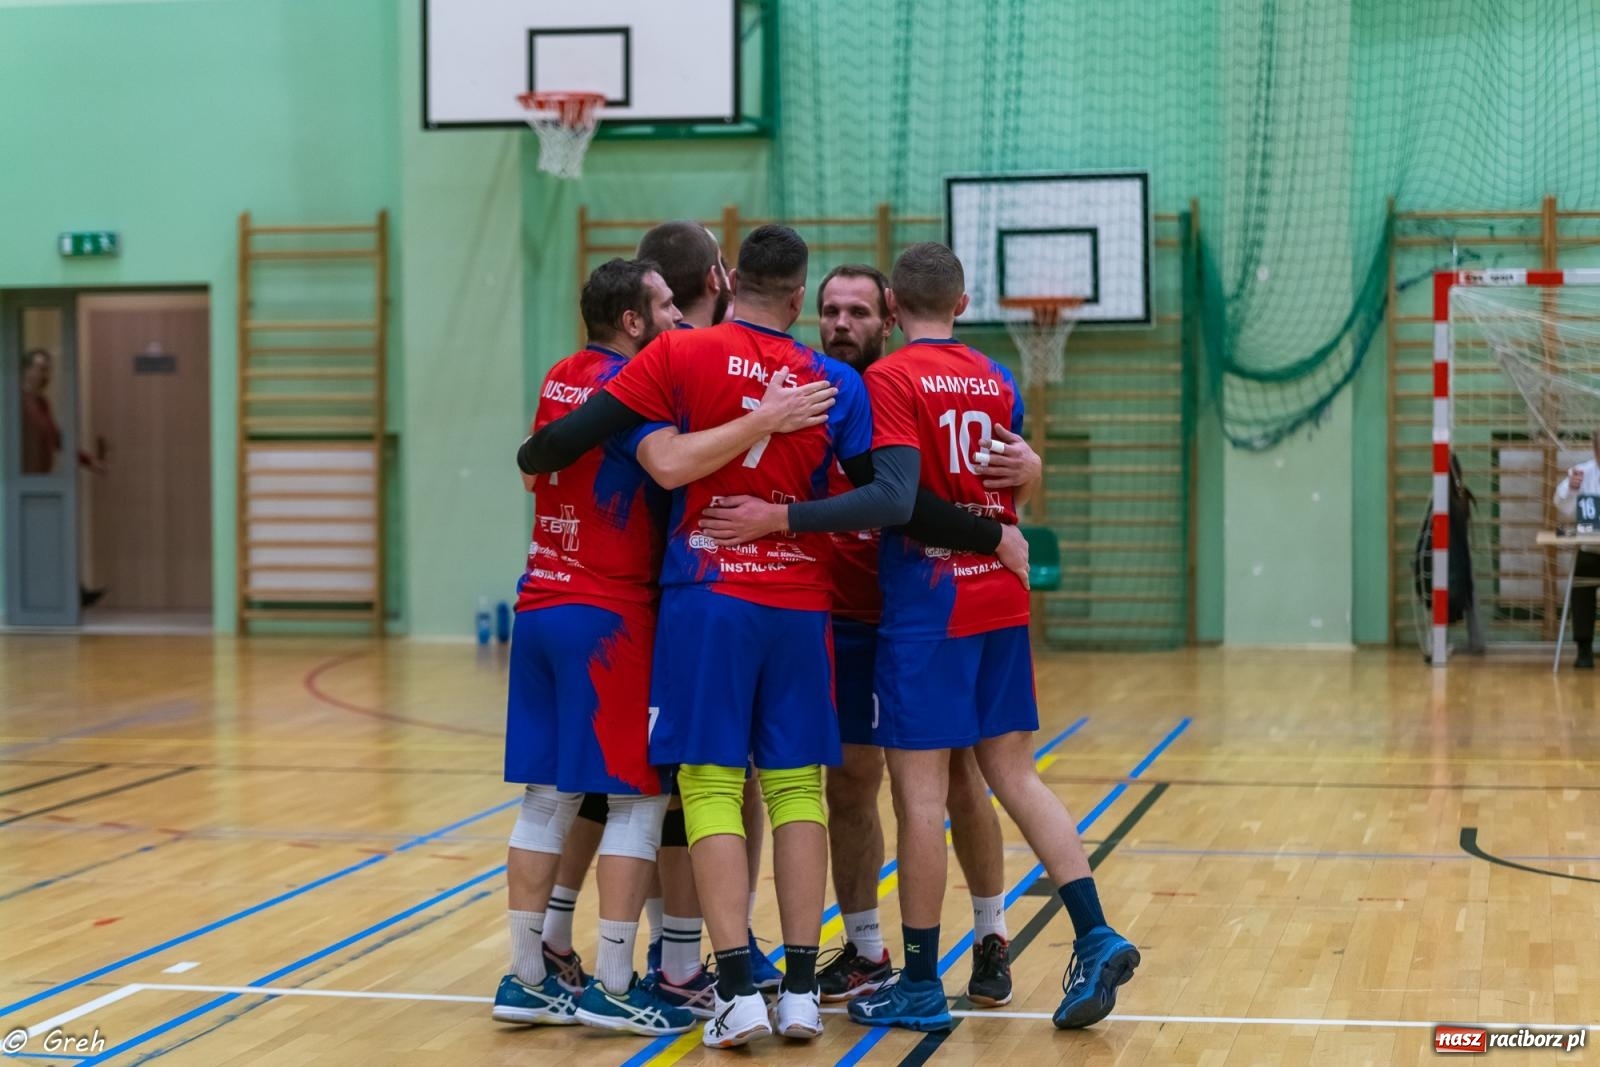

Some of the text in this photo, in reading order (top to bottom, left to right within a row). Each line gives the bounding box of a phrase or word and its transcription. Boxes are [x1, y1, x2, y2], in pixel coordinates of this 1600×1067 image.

[728, 356, 798, 388] BIAŁS
[921, 376, 1000, 396] NAMYSŁO
[939, 409, 992, 476] 10
